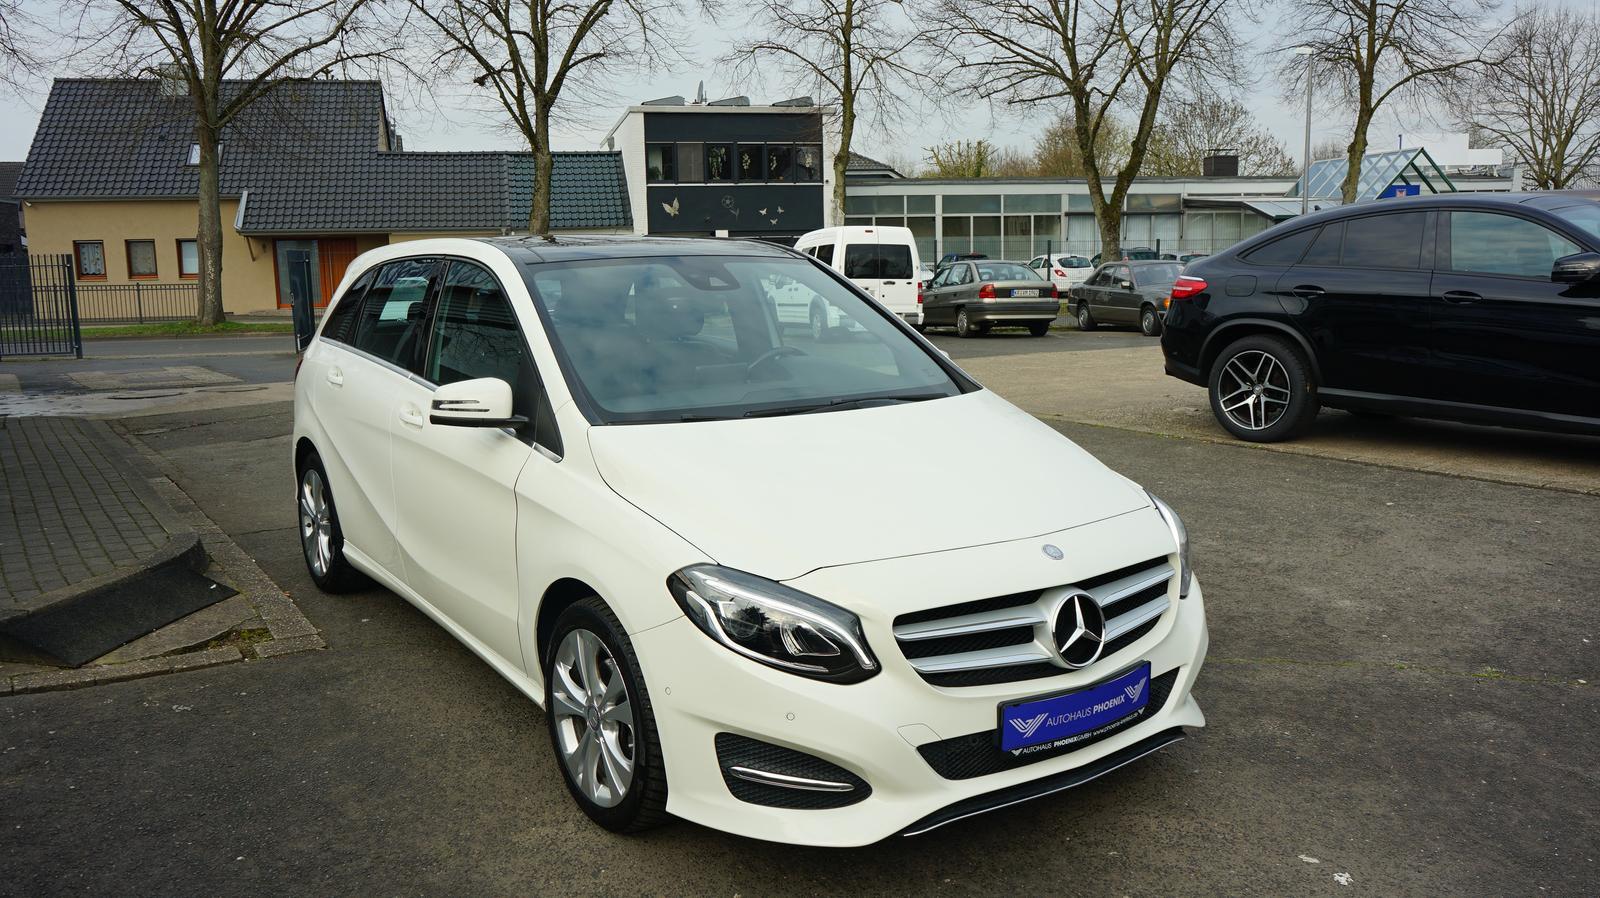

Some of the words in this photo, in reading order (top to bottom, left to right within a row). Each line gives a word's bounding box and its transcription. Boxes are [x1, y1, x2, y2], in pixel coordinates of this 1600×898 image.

[1045, 708, 1092, 728] AUTOHAUS
[1092, 694, 1126, 715] PHOENIX
[1022, 742, 1052, 755] AUTOHAUS
